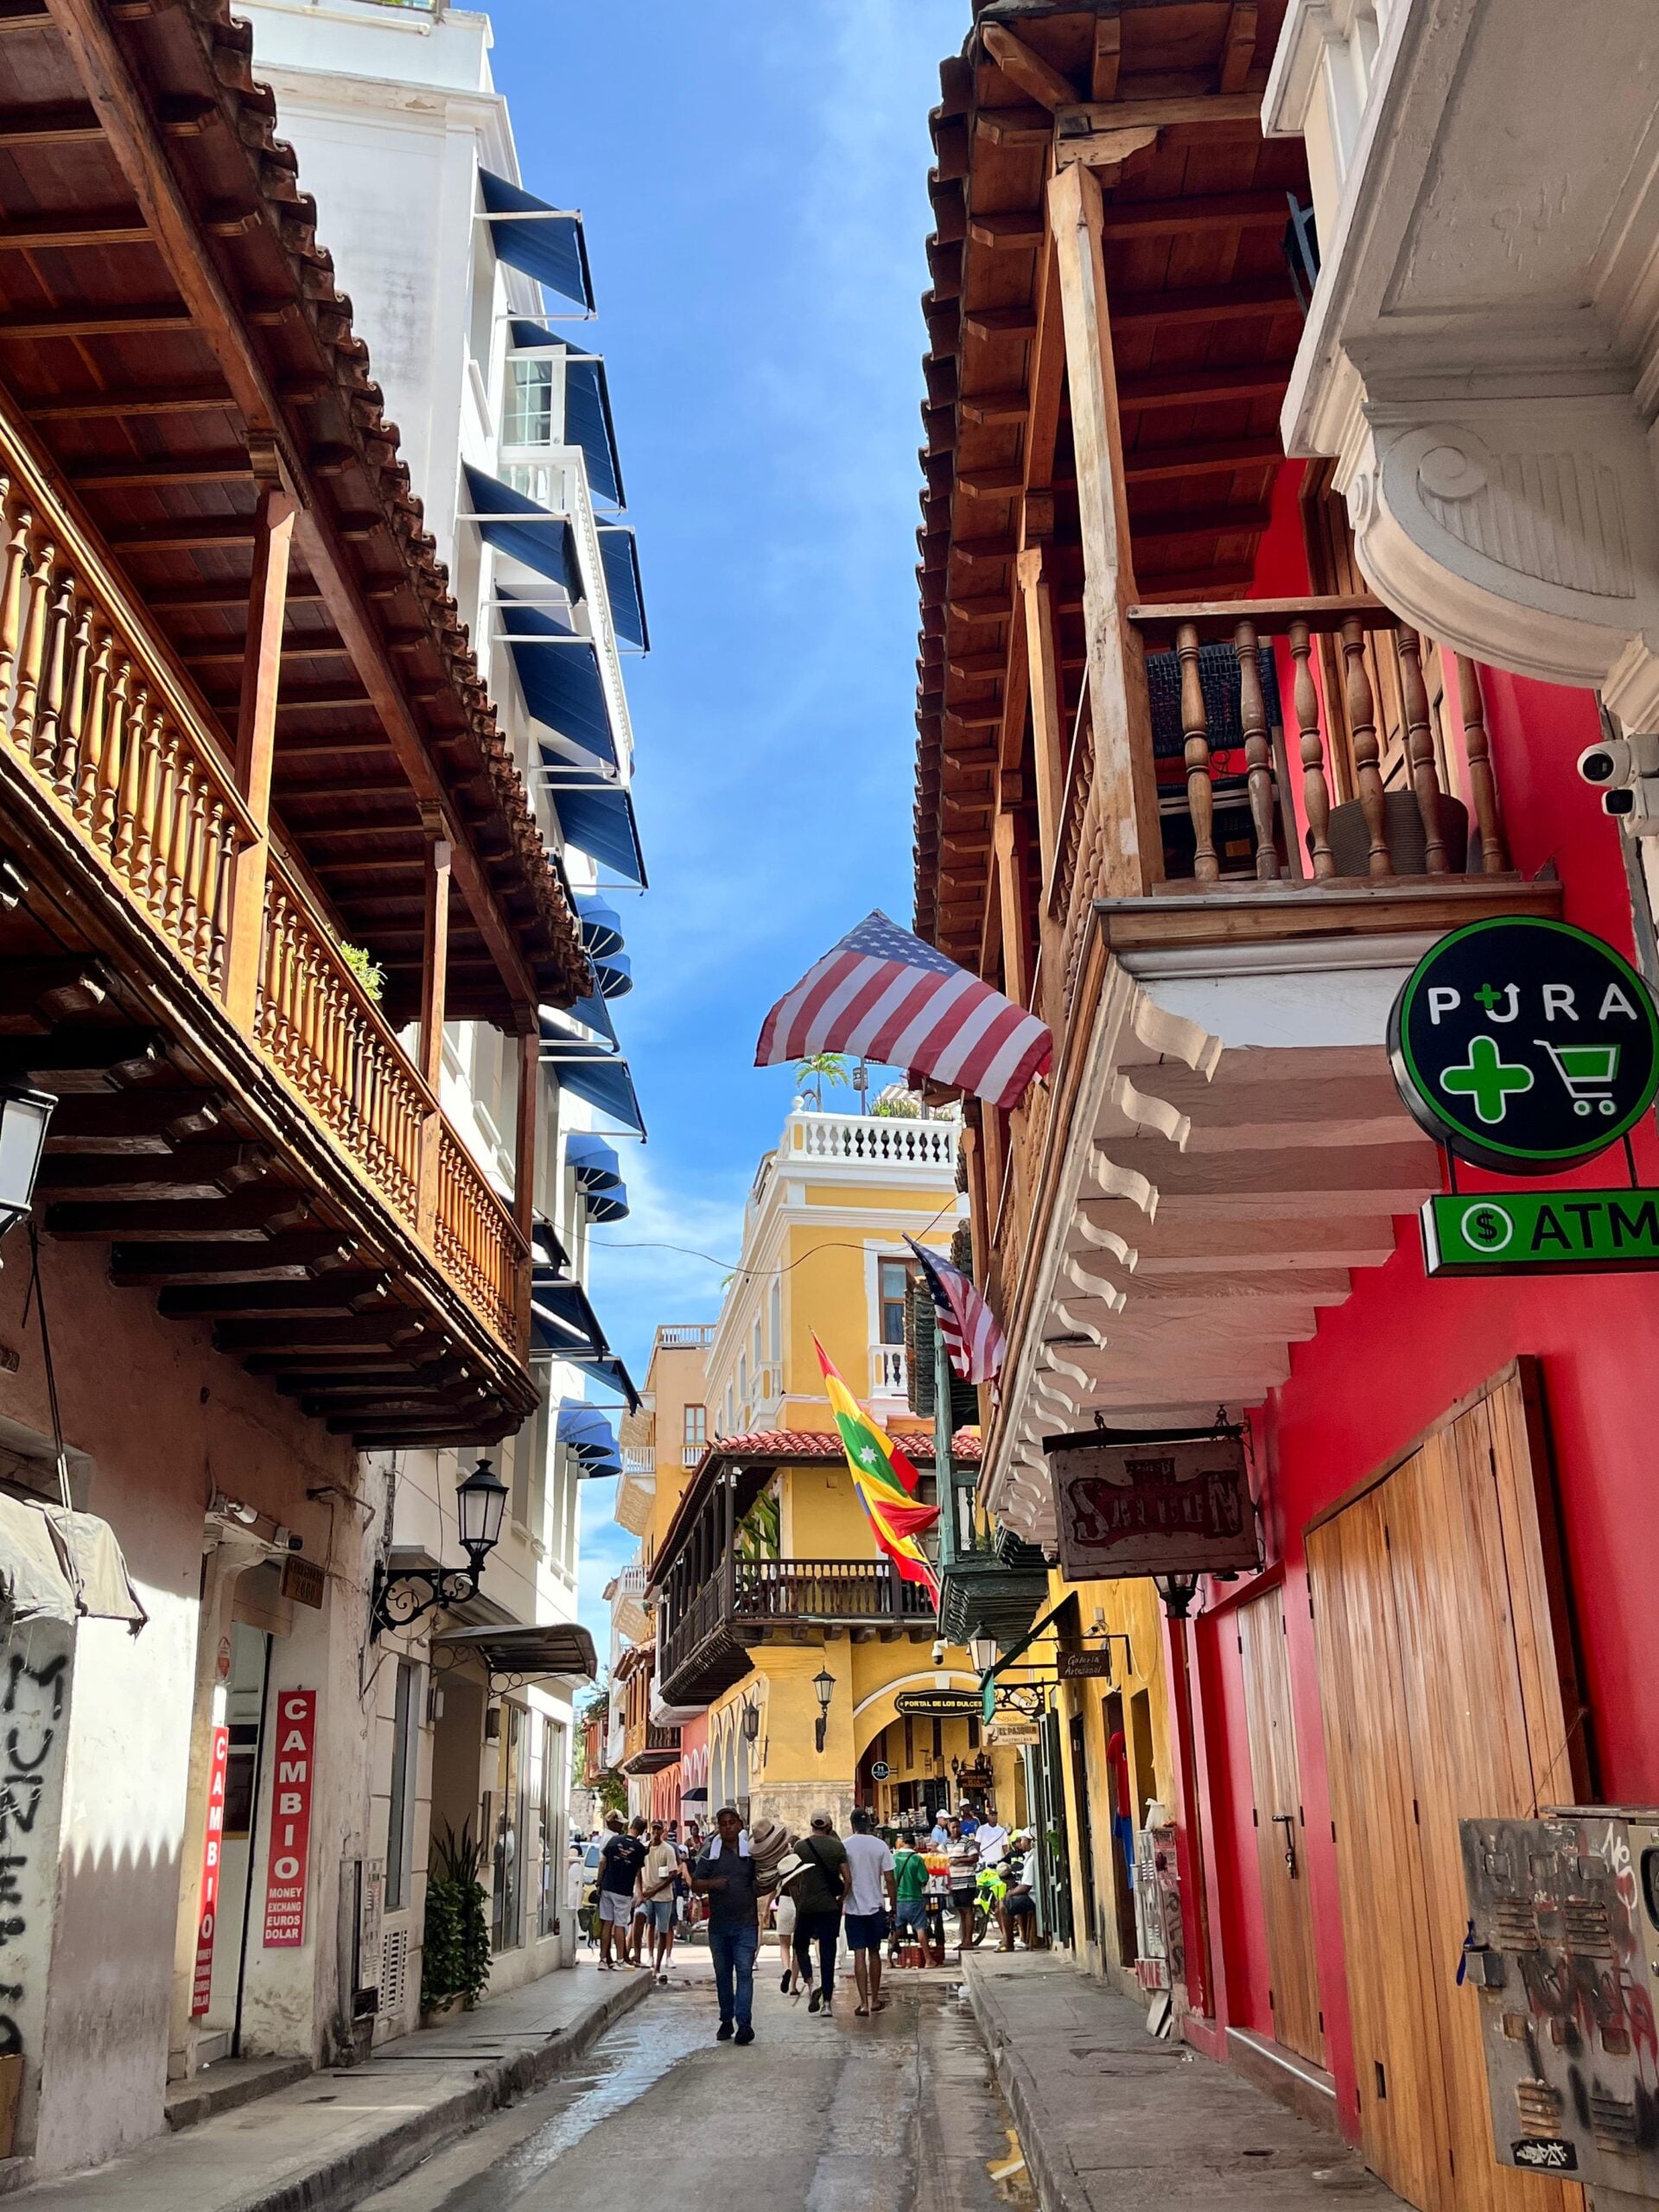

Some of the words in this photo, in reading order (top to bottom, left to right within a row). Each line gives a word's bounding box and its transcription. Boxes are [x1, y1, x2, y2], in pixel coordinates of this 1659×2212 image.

[1427, 982, 1637, 1025] PURA
[1530, 1200, 1659, 1251] ATM
[274, 1698, 308, 1879] CAMBIO
[201, 1737, 226, 1939] CAMBIO
[269, 1887, 302, 1898] MONEY
[268, 1901, 302, 1912] EXCHANG
[265, 1928, 299, 1939] DOLAR
[267, 1915, 301, 1926] EUROS
